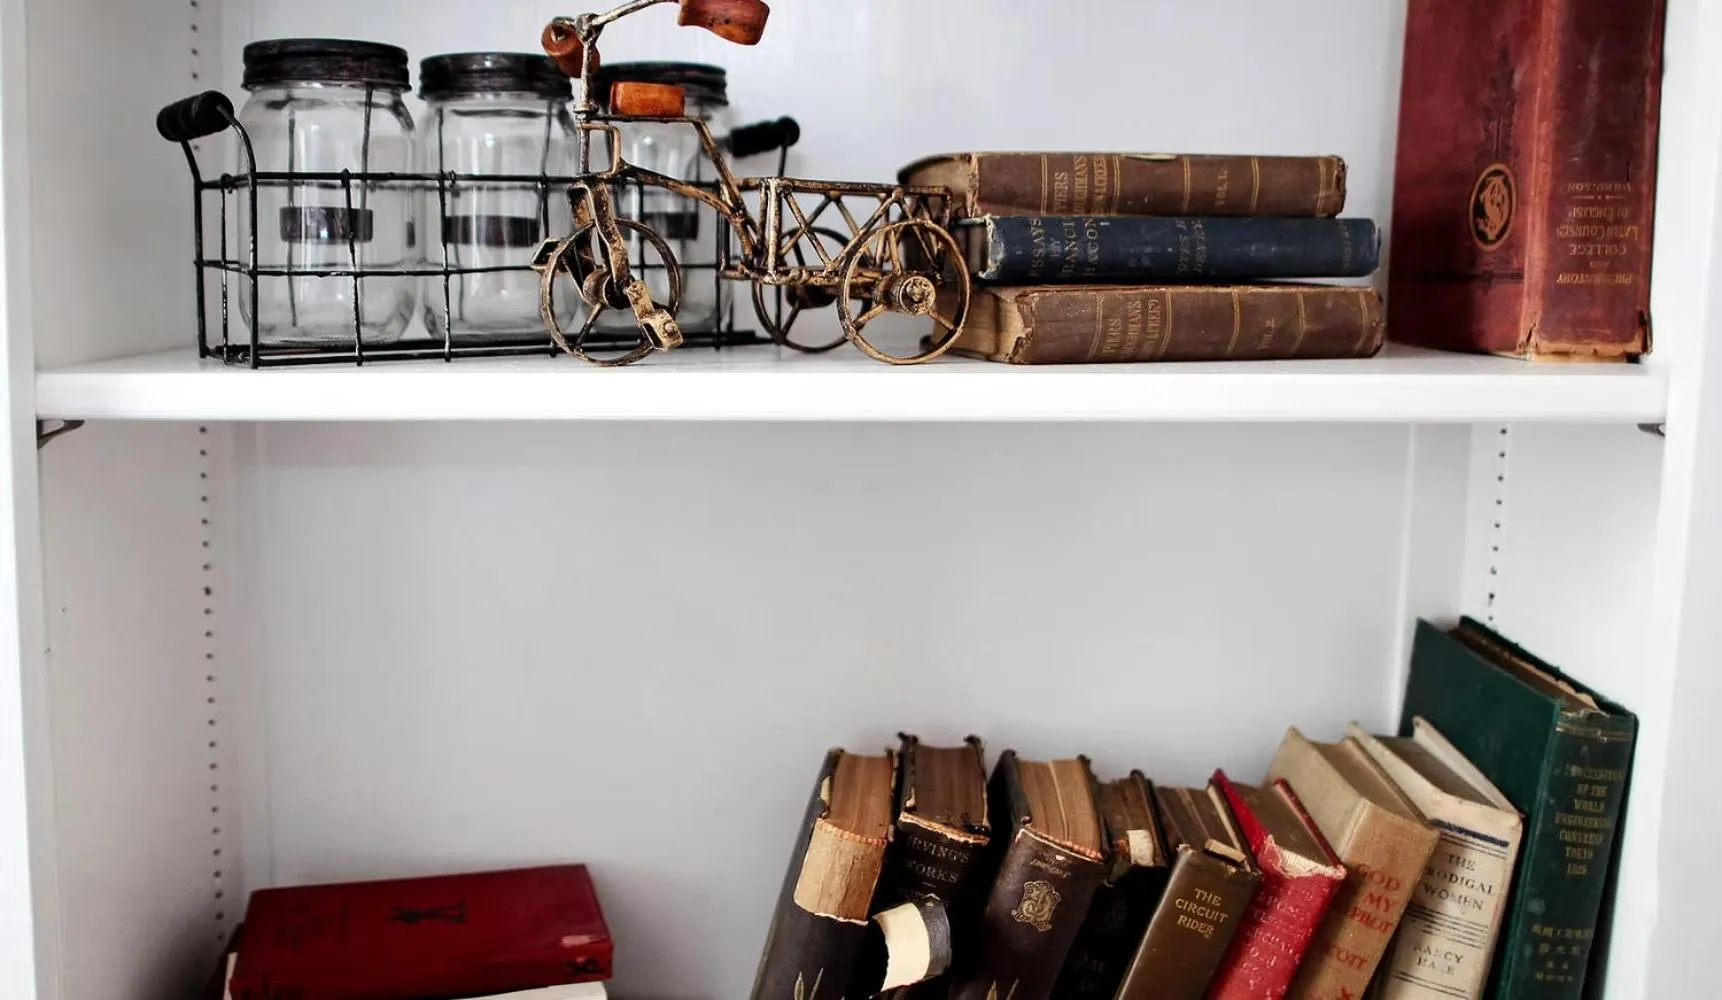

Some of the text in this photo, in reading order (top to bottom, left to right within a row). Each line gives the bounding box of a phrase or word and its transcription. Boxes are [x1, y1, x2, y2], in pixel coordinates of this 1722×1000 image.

[1567, 243, 1628, 256] COLLEGE
[1447, 854, 1477, 872] THE
[1356, 863, 1401, 891] GOD
[1424, 865, 1496, 896] RODIGAL
[1193, 887, 1223, 906] THE
[1365, 892, 1399, 913] MY
[1423, 883, 1485, 911] WOMEN
[1174, 897, 1229, 923] CIRCUIT
[1176, 914, 1215, 936] RIDER
